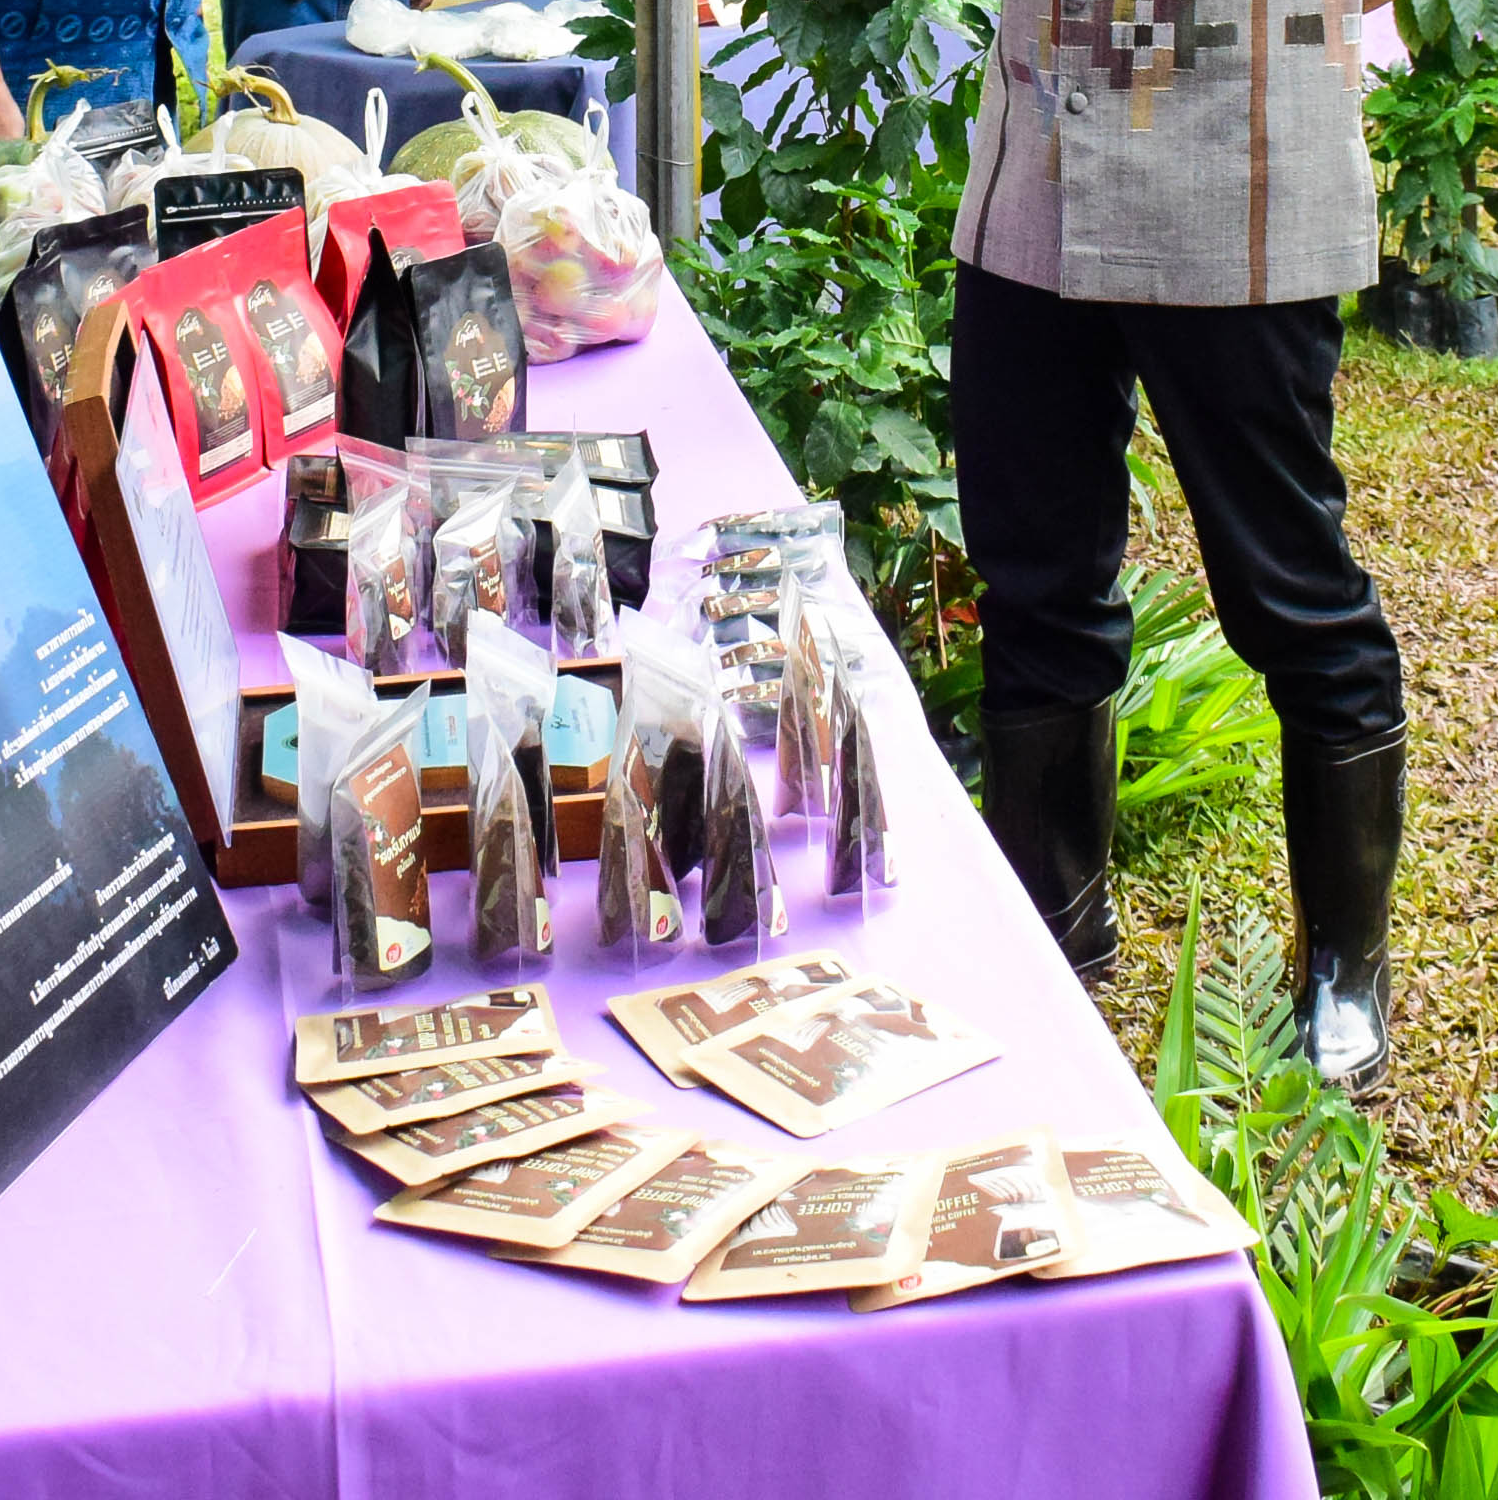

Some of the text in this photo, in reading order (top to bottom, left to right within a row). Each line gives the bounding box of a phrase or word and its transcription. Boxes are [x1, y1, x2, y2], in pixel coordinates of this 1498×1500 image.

[518, 1154, 603, 1184] DRIP COFFEE
[630, 1182, 684, 1208] COFFEE
[1071, 1180, 1132, 1194] COFFEE
[795, 1200, 853, 1215] COFFEE
[933, 1191, 981, 1212] OFFEE
